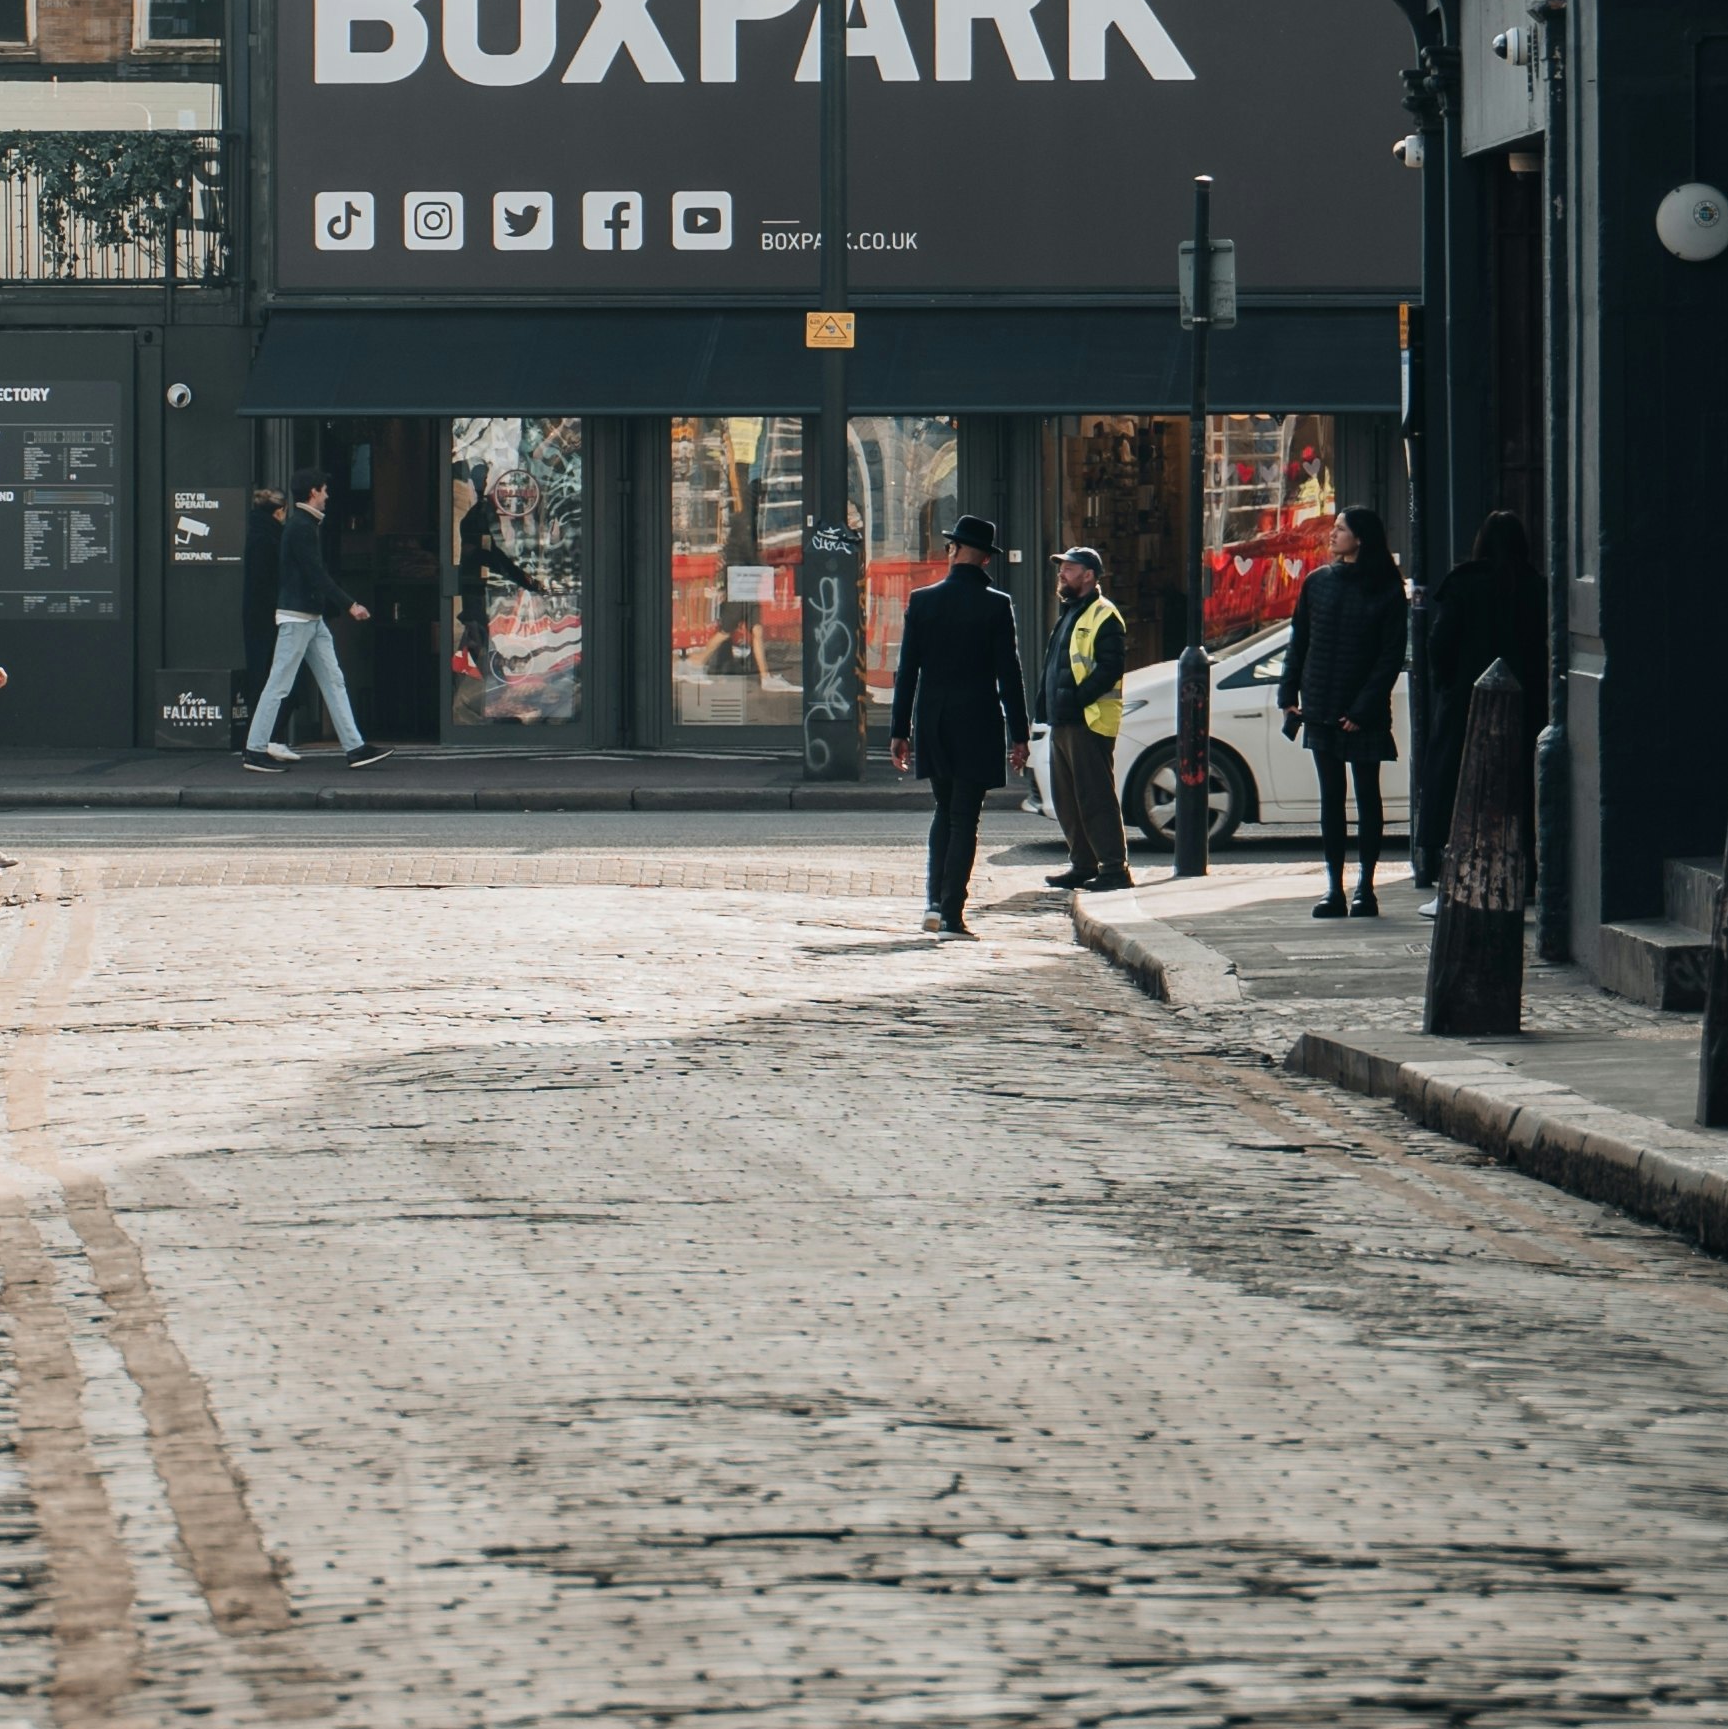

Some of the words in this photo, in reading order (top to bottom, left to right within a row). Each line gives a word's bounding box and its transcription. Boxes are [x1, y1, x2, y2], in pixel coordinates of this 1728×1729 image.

[761, 232, 918, 251] BOXPA.CO.UK
[175, 493, 196, 501] CCTV
[197, 493, 205, 501] IN
[175, 501, 219, 509] OPERATION
[175, 552, 213, 561] BOXPARK
[178, 691, 207, 705] Viva
[163, 706, 222, 719] FALAFEL
